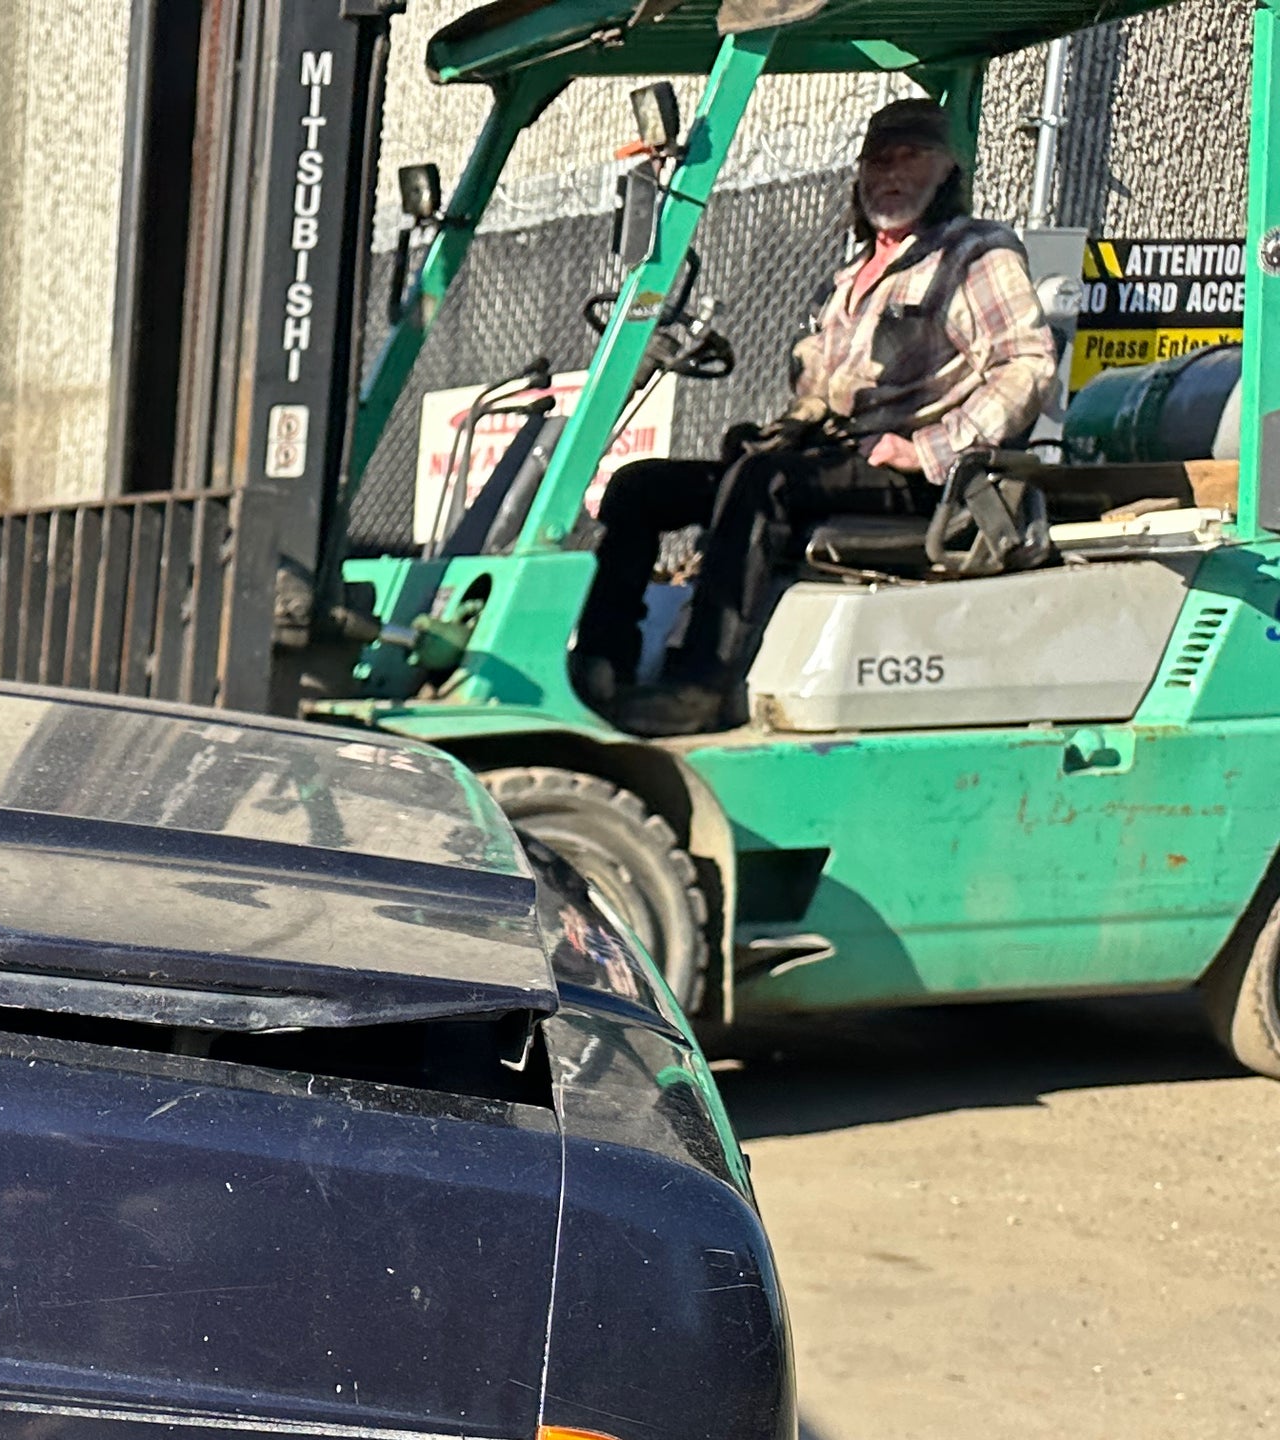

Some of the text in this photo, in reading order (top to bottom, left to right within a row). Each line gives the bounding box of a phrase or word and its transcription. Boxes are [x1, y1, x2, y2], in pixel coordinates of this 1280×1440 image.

[282, 50, 334, 383] MITSUBISHI
[1118, 282, 1178, 313] YARD
[1086, 335, 1150, 360] Please
[856, 654, 945, 687] FG35
